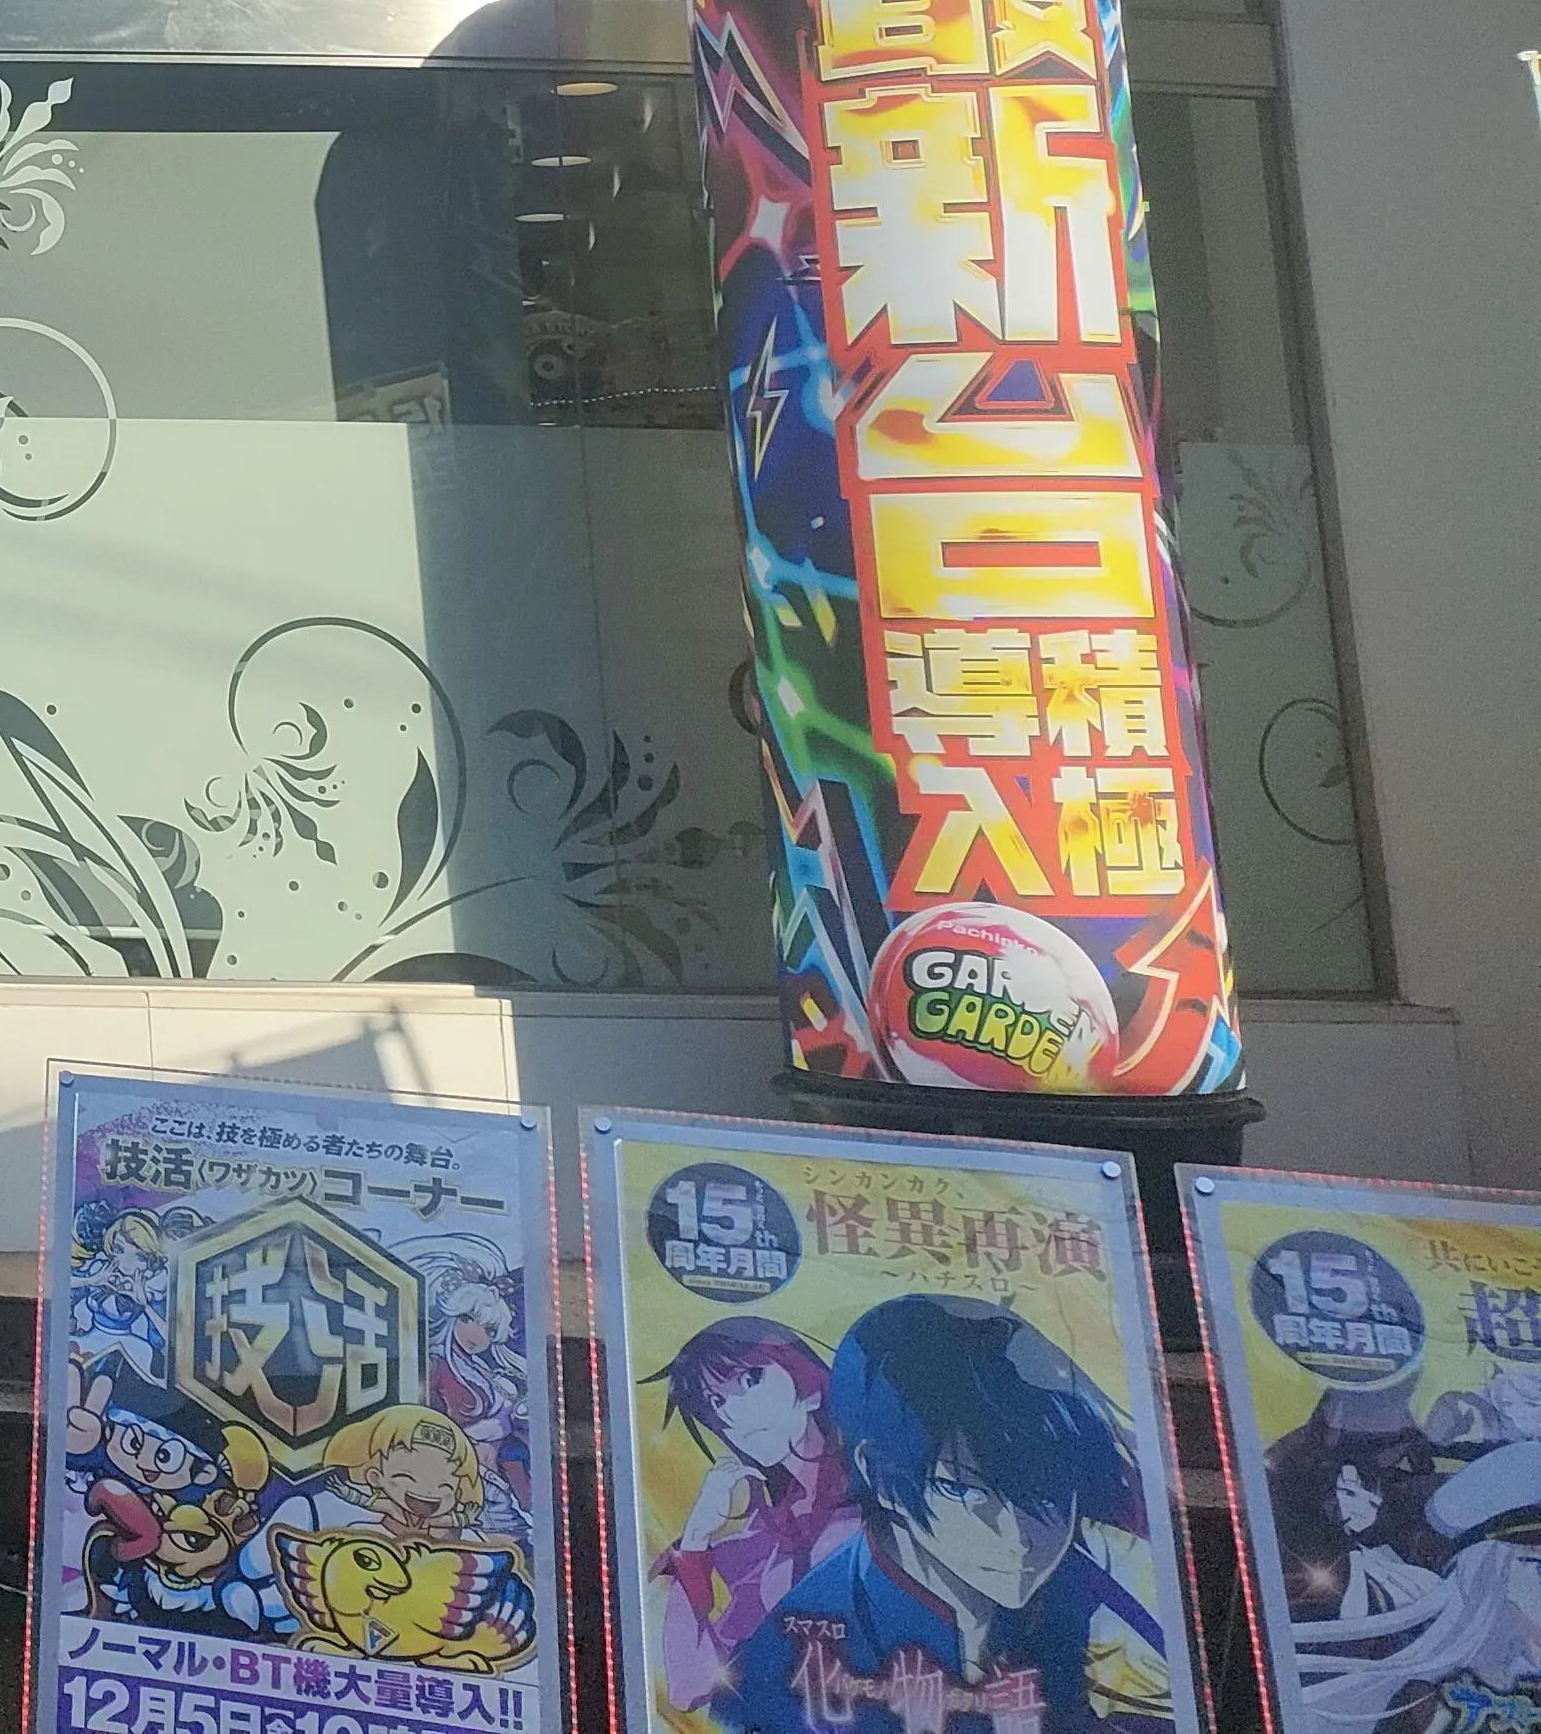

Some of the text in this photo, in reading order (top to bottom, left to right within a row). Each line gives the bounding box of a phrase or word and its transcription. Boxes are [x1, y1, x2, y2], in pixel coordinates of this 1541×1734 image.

[151, 1116, 463, 1171] ここは、技を極める者たちの舞台。
[803, 1166, 965, 1199] シンカンカク、
[665, 1180, 754, 1246] 15
[806, 1188, 1107, 1283] 怪異再演
[665, 1240, 788, 1280] 周年月間
[1269, 1249, 1369, 1318] 15
[1272, 1315, 1414, 1357] 周年月間
[783, 1616, 846, 1639] スマスロ
